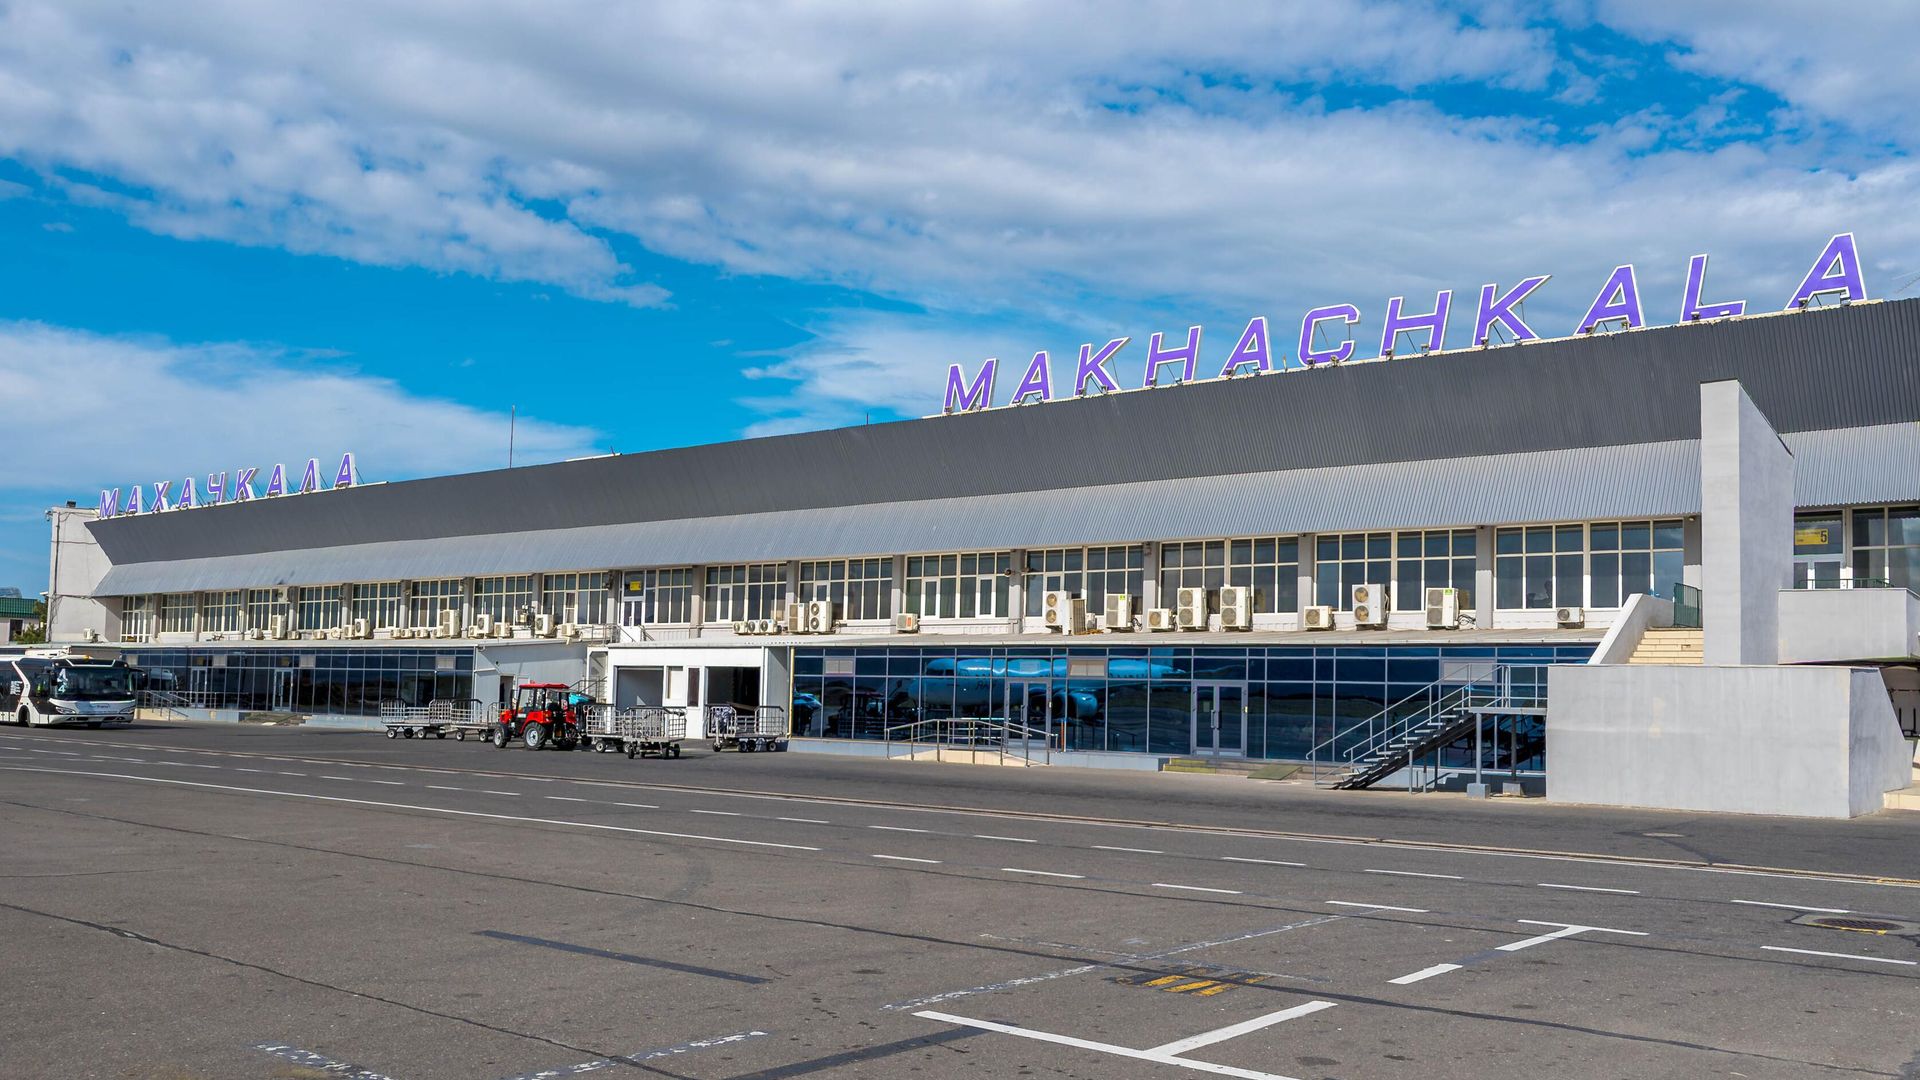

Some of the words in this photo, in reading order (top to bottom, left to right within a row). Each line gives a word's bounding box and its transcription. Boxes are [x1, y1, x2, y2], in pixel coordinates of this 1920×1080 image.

[943, 232, 1868, 415] MAKHACHKALA
[99, 452, 356, 518] МАХАЧКАЛА
[1820, 530, 1828, 543] 5
